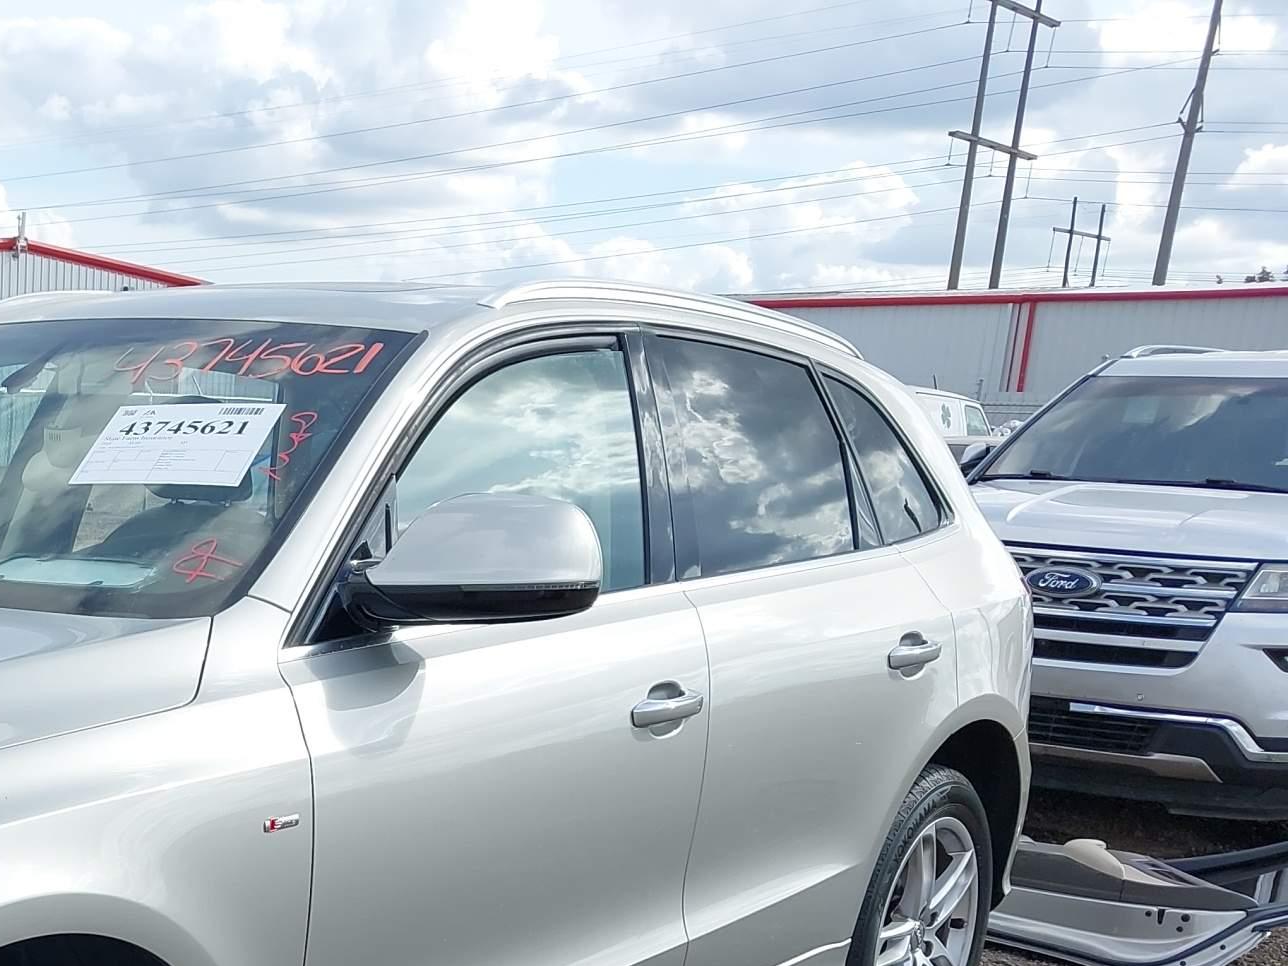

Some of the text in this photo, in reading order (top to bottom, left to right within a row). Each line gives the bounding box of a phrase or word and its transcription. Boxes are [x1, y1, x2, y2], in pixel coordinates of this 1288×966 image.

[113, 338, 385, 384] 43745621
[119, 419, 250, 436] 43745621
[1038, 572, 1080, 589] Ford
